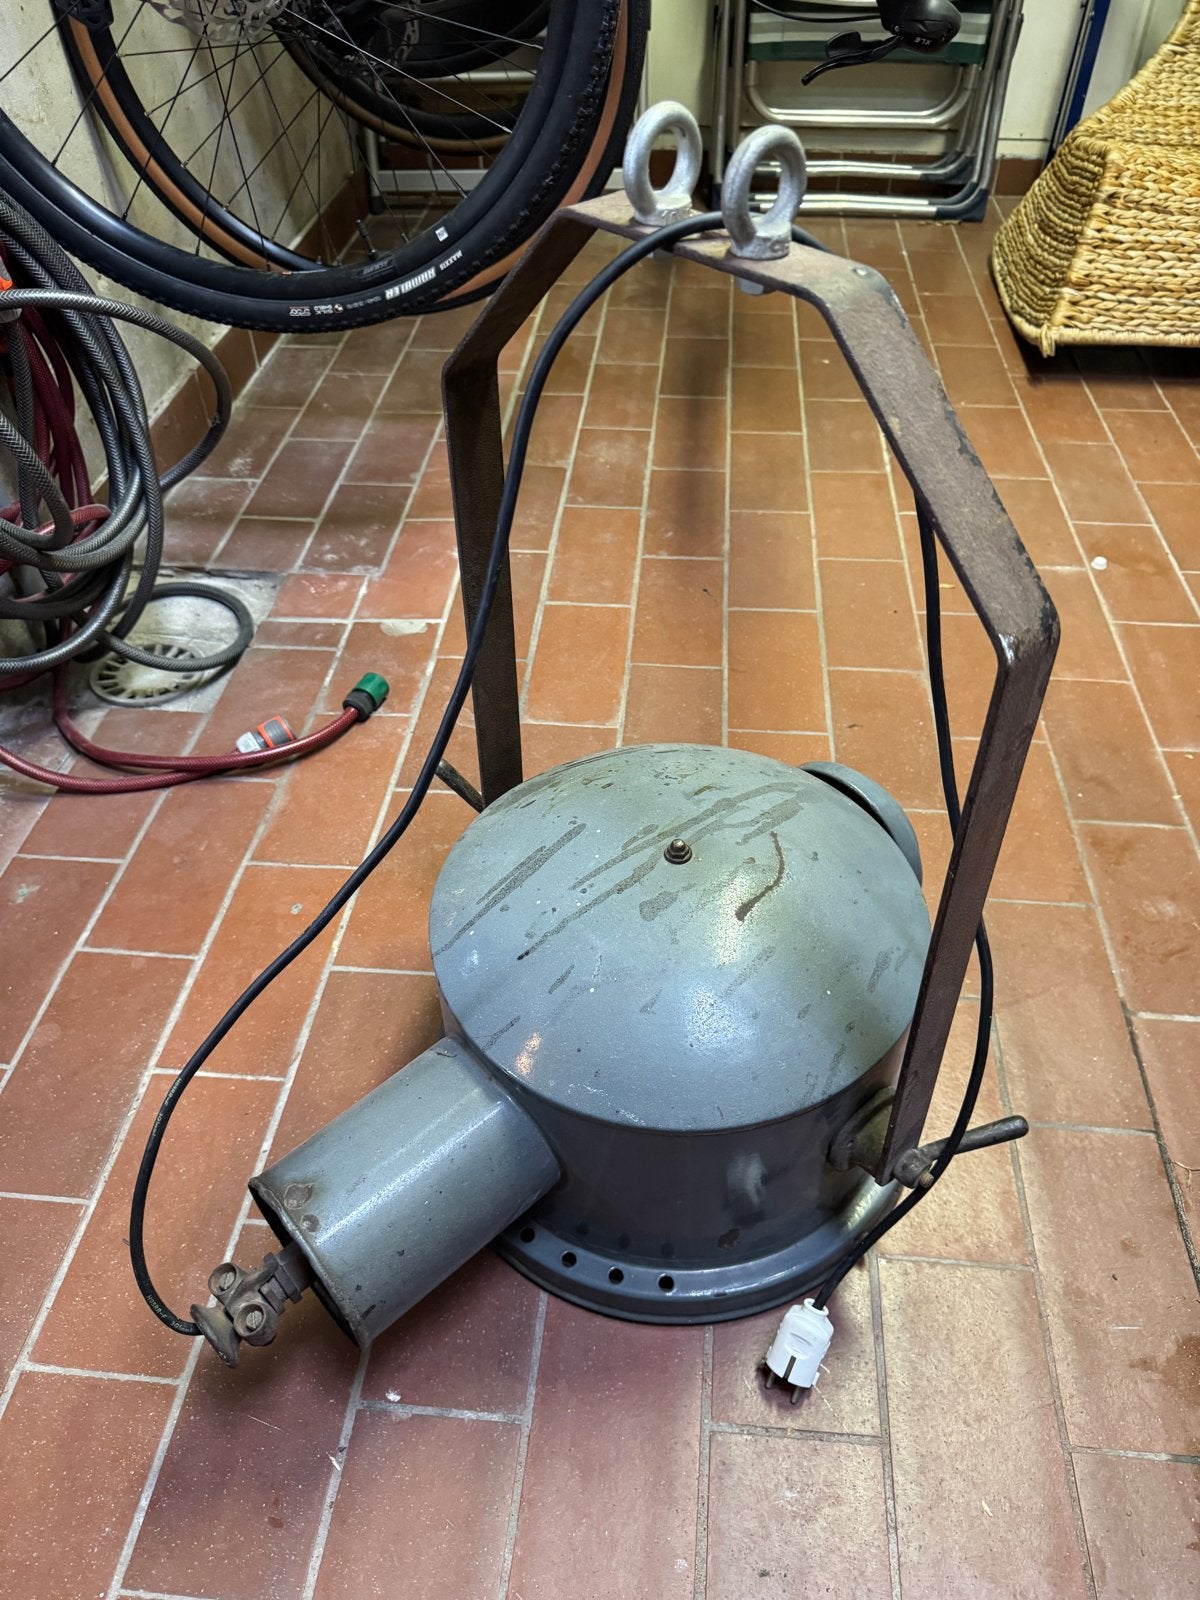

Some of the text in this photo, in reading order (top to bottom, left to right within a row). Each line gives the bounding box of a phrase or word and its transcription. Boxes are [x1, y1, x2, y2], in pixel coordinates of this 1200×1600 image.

[914, 36, 932, 46] XLE
[439, 249, 463, 271] MAXXIS
[385, 266, 435, 300] RAMBLER
